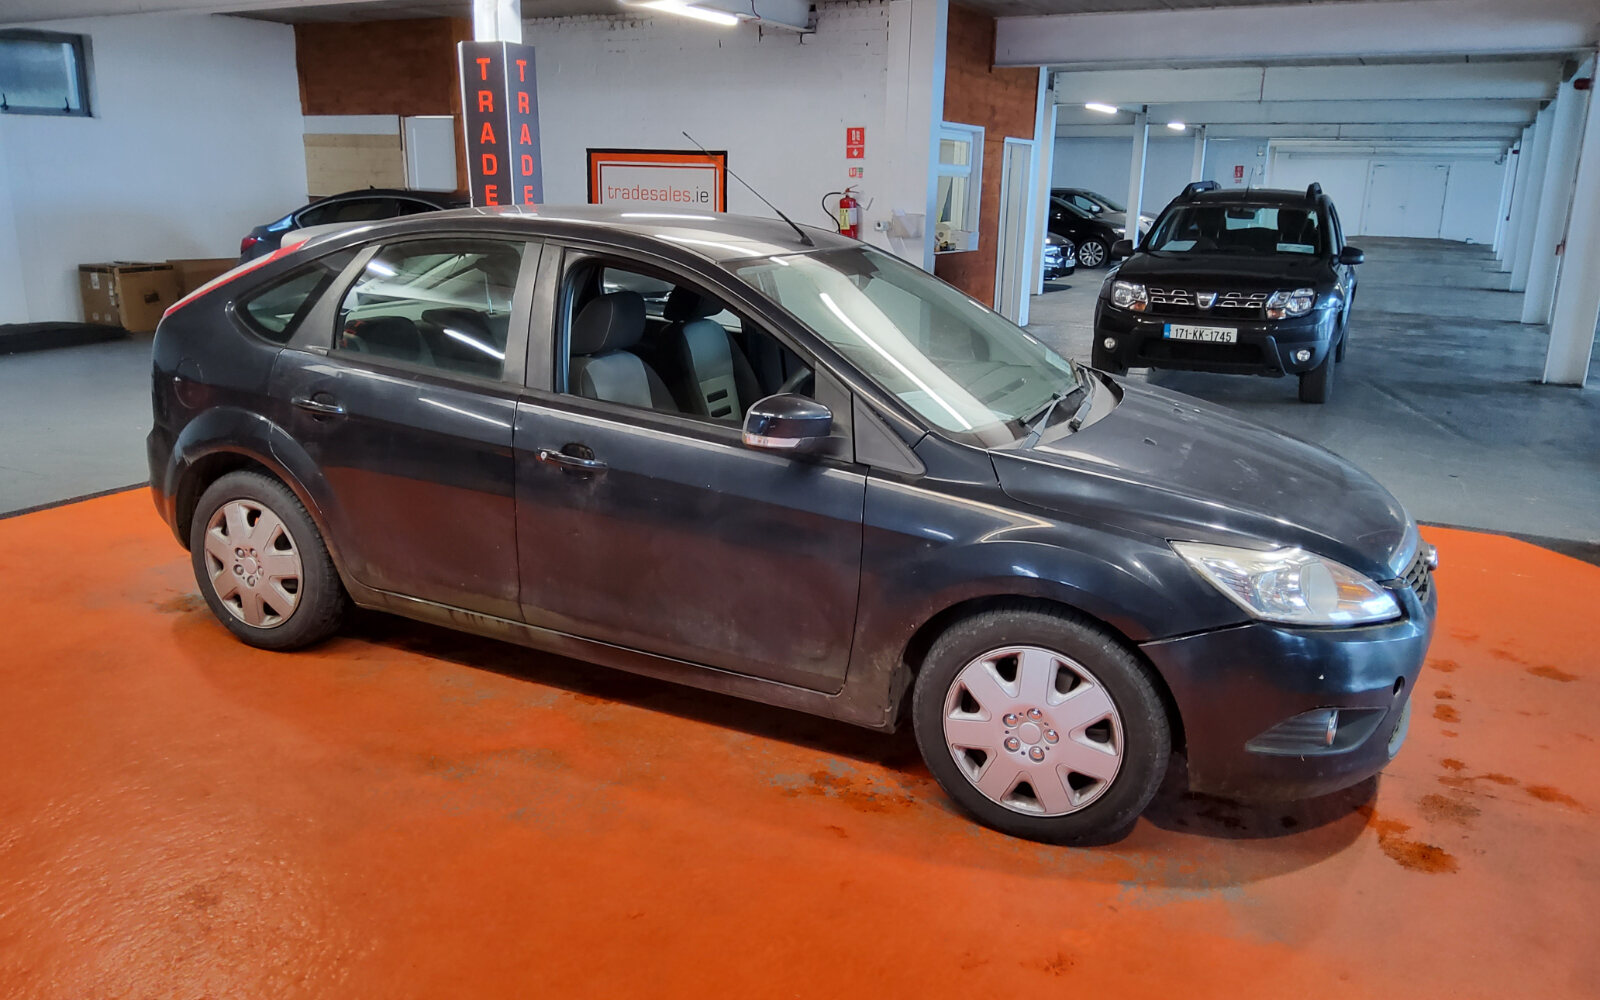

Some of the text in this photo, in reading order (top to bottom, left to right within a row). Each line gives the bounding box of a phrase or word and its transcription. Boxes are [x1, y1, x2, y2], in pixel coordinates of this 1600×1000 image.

[476, 57, 498, 206] TRADE
[516, 59, 534, 206] TRADE
[607, 184, 709, 203] tradesales.ie
[1175, 327, 1232, 343] 171-KK-1745
